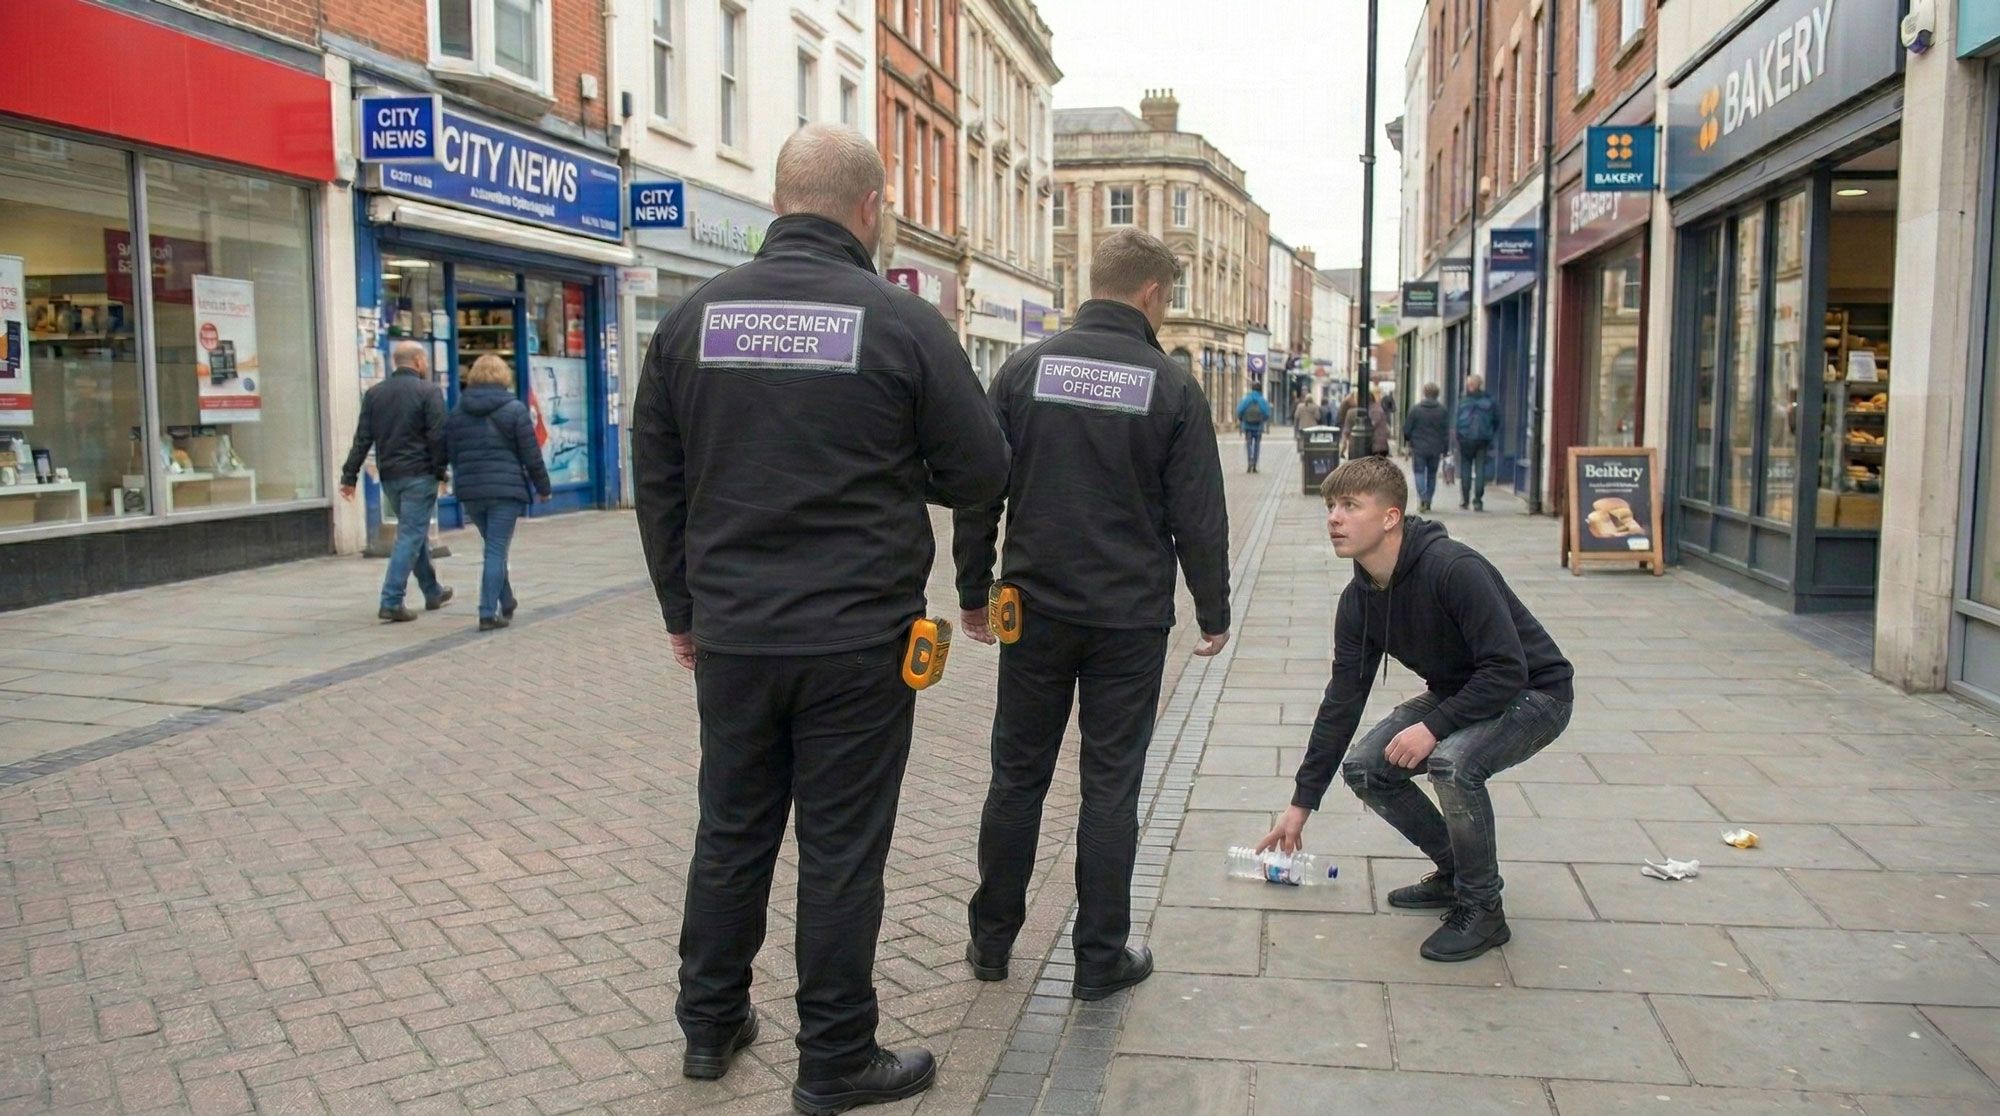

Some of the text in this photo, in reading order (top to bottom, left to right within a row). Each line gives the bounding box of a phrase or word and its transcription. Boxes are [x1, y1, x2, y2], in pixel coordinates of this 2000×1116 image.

[1723, 0, 1834, 135] BAKERY
[377, 108, 420, 127] CITY
[372, 129, 427, 149] NEWS
[441, 125, 578, 203] CITY NEWS
[1594, 173, 1643, 184] BAKERY
[640, 189, 674, 204] CITY
[635, 206, 678, 220] NEWS
[709, 314, 853, 334] ENFORCEMENT
[736, 334, 819, 354] OFFICER
[1045, 364, 1147, 387] ENFORCEMENT
[1062, 380, 1122, 399] OFFICER
